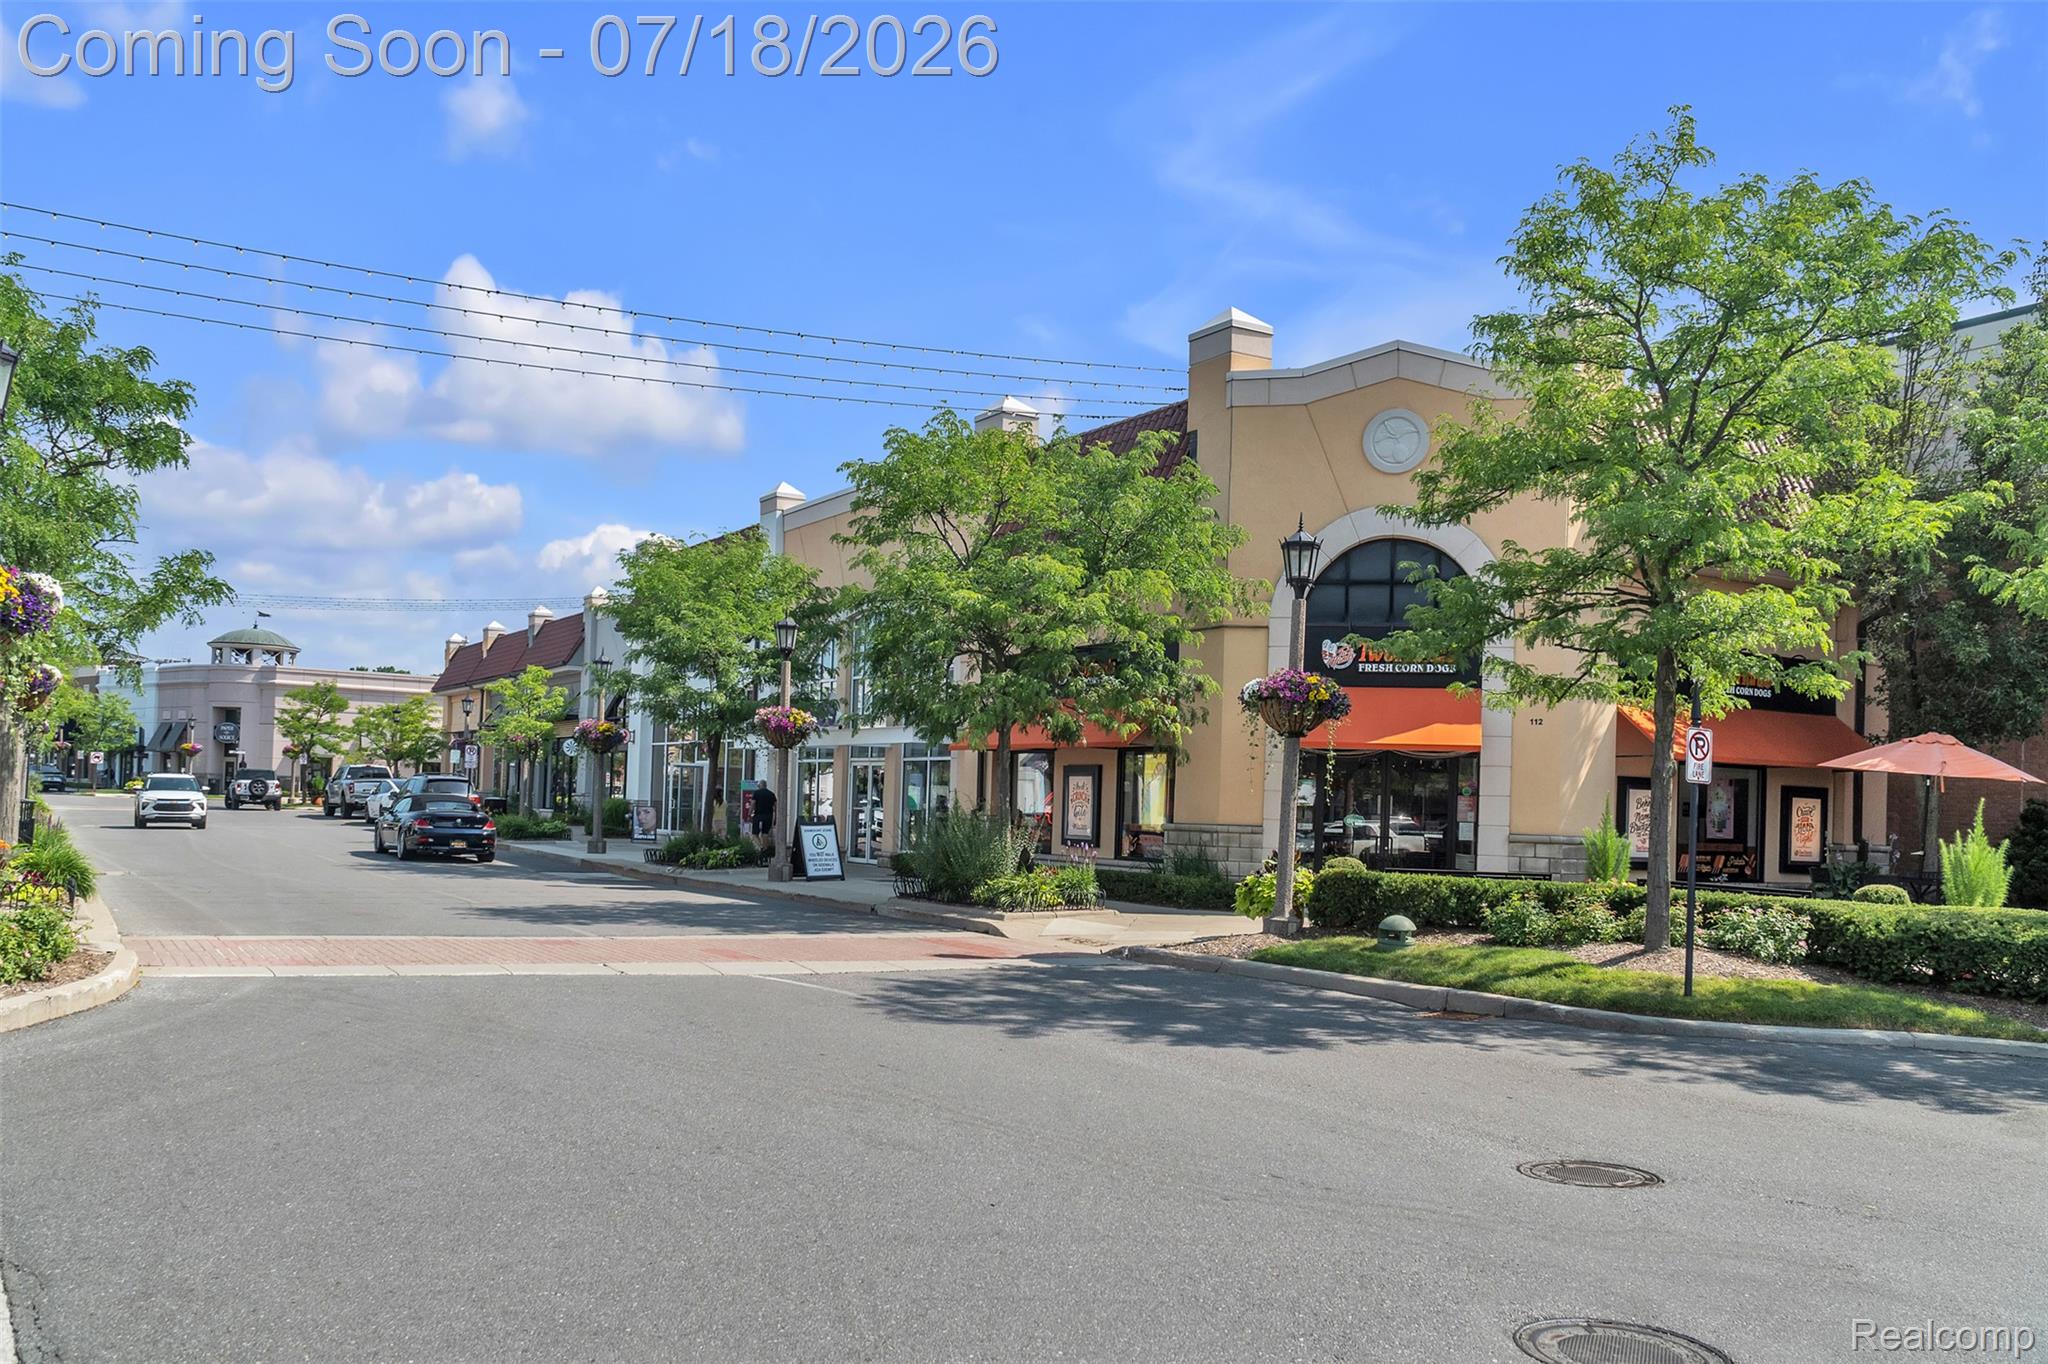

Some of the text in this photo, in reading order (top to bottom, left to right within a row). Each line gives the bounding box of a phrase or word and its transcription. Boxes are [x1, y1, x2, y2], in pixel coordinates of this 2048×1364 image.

[1358, 663, 1393, 673] FRESH
[1395, 664, 1424, 673] CORN
[1735, 686, 1754, 696] CORN
[1754, 688, 1772, 698] DOGS
[1530, 718, 1544, 726] 112
[1693, 763, 1705, 771] FIRE
[1692, 770, 1705, 779] LANE
